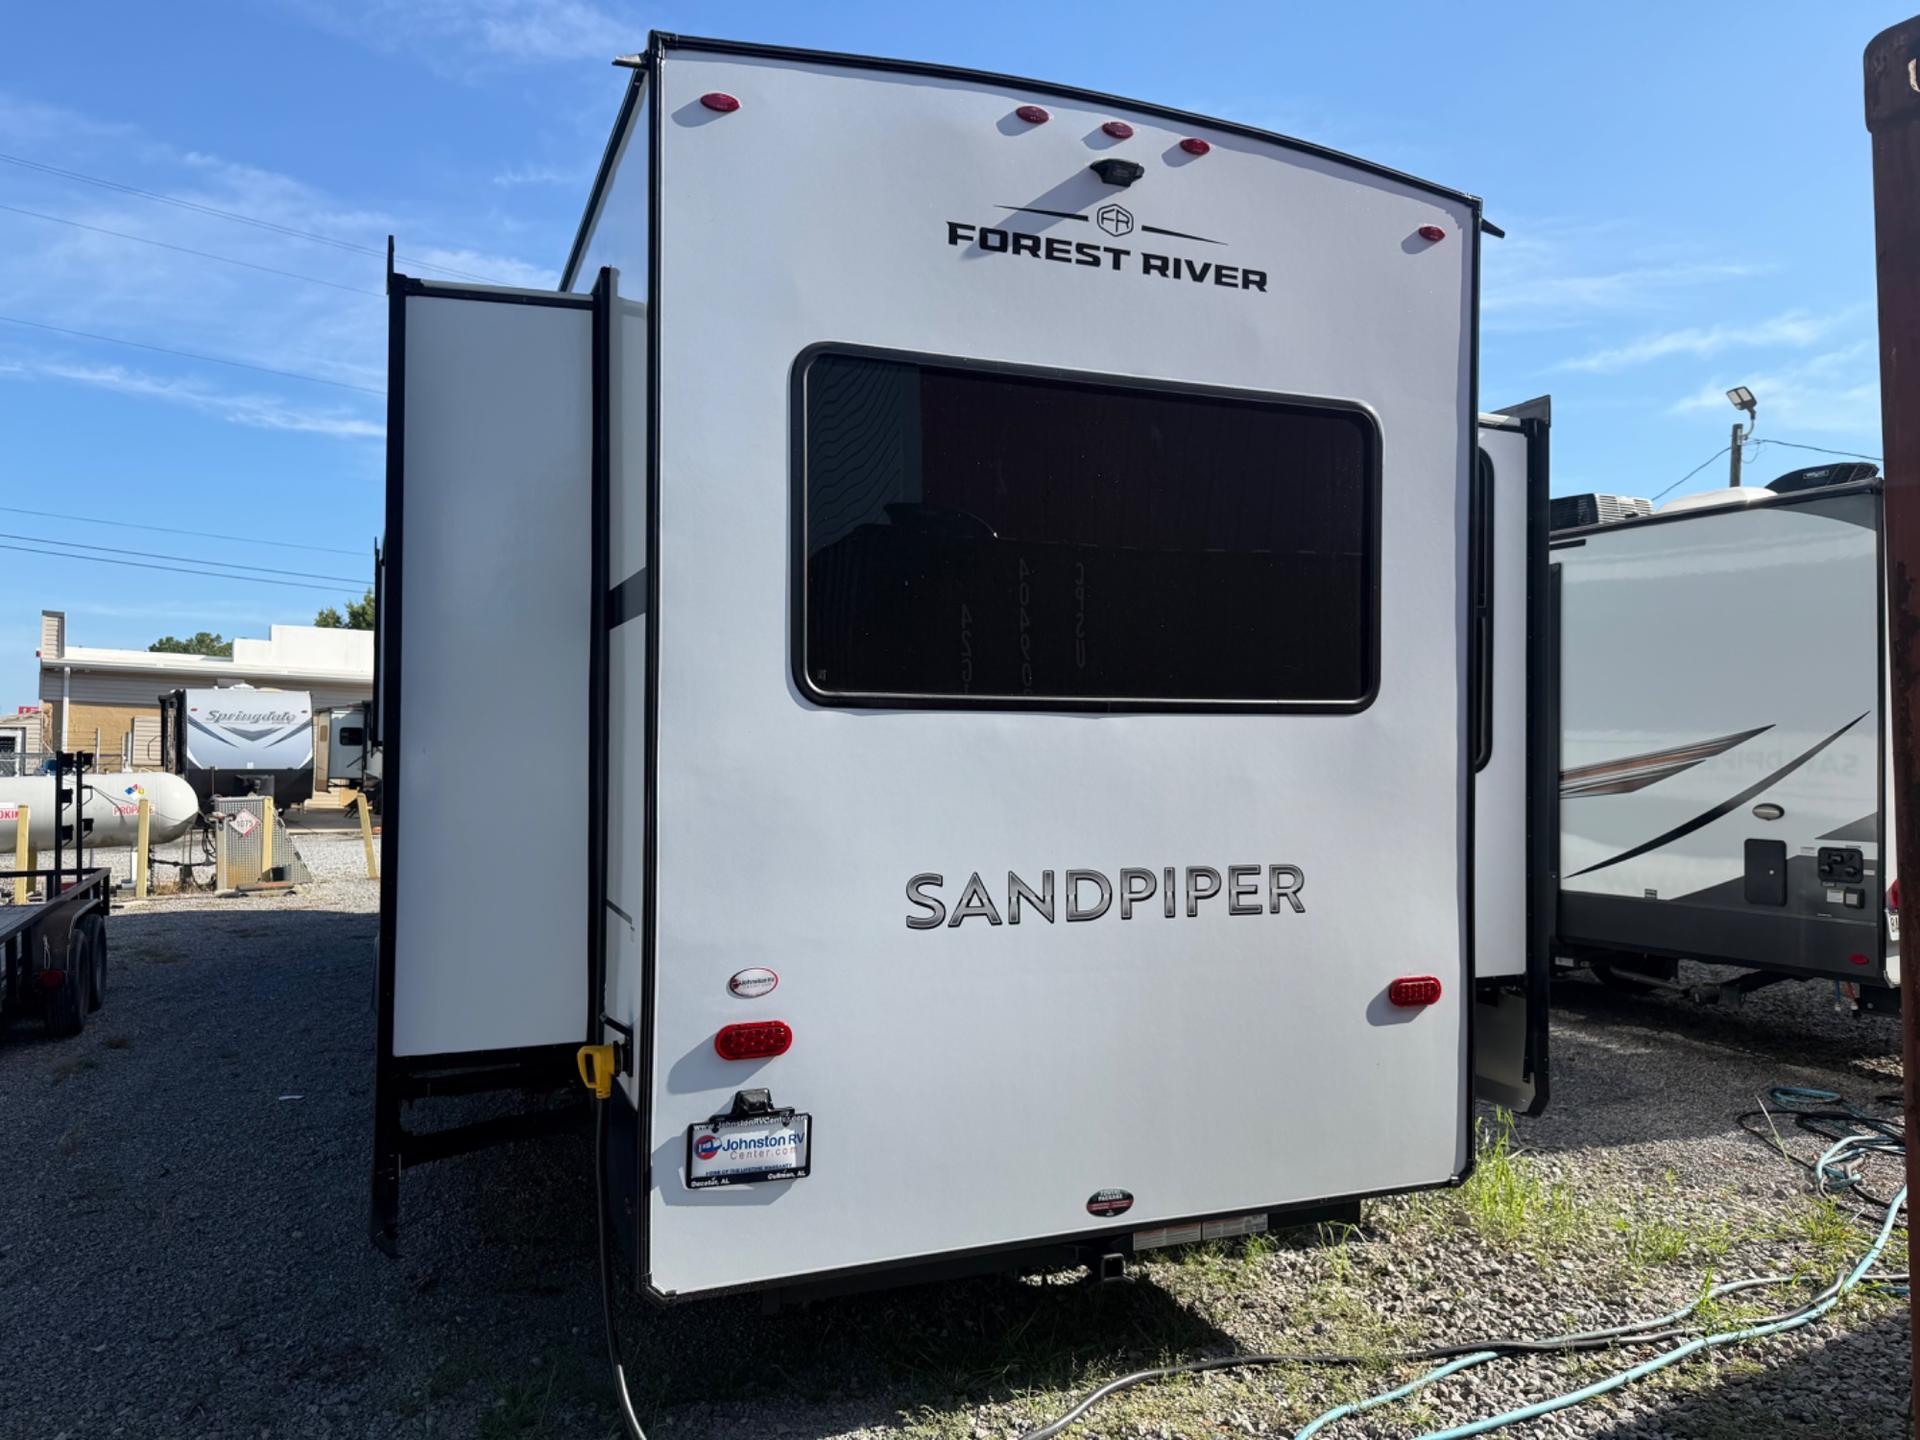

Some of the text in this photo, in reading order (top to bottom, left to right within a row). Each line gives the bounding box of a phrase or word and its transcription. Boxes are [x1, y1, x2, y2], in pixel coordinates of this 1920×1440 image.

[946, 221, 1268, 293] FOREST RIVER
[205, 710, 297, 724] Springdale
[905, 863, 1306, 930] SANDPIPER
[722, 1133, 805, 1151] Johnston RV
[730, 1148, 798, 1160] Center.com
